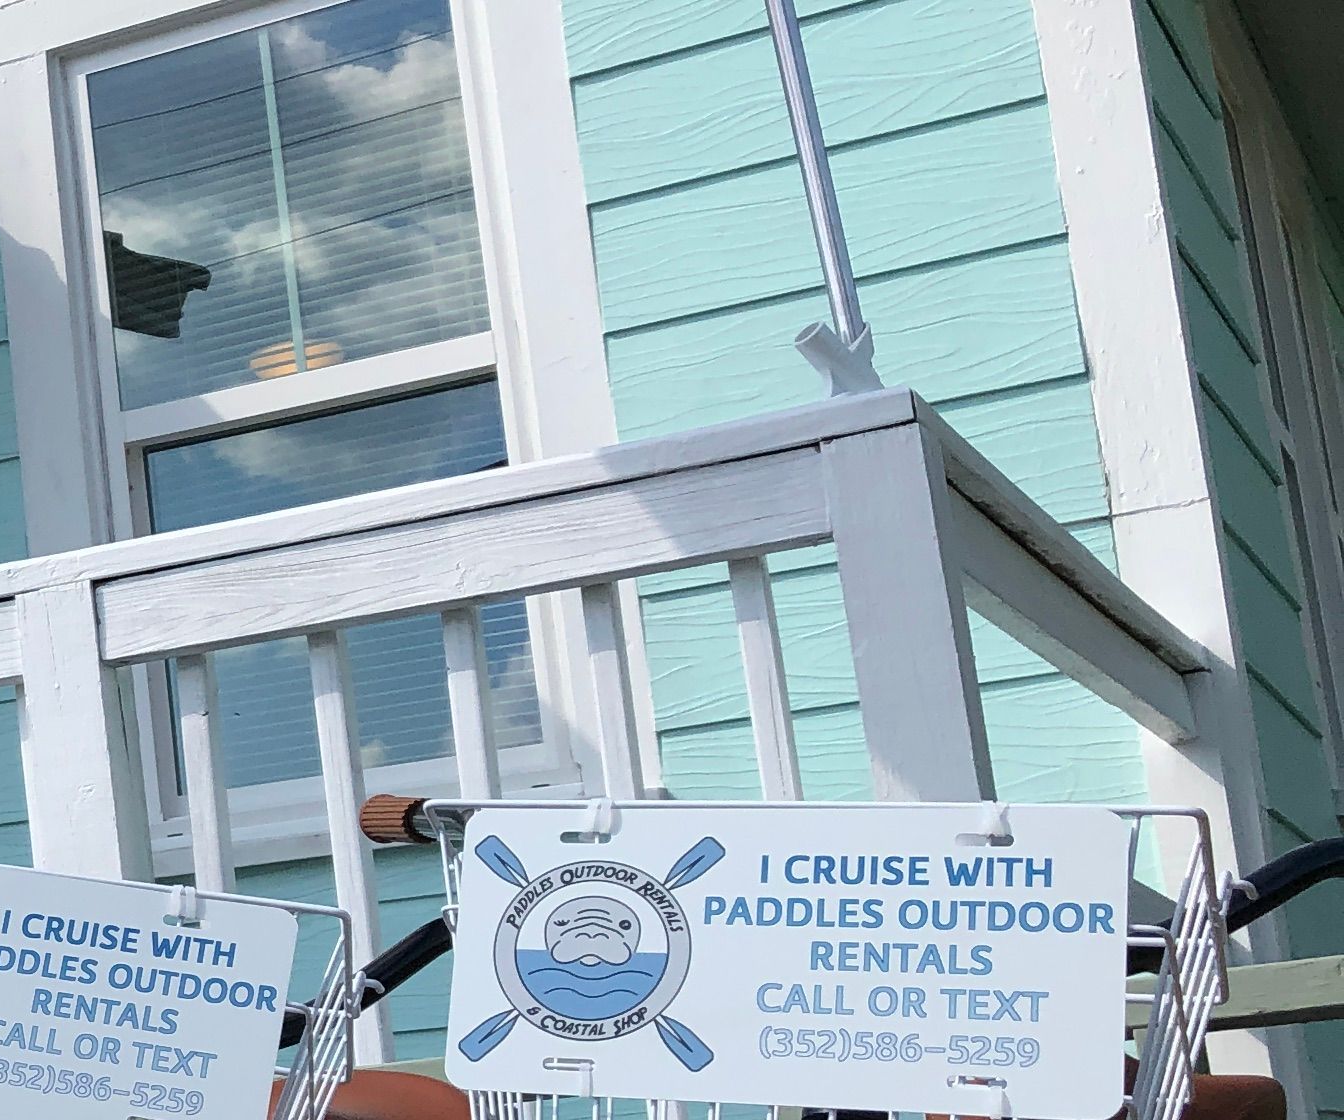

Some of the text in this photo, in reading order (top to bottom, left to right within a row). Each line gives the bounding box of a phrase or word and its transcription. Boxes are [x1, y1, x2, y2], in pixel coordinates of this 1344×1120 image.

[761, 855, 1052, 887] I CRUISE WITH
[506, 865, 683, 933] PADDLES OUTDOOR RENTALS
[704, 896, 1114, 933] PADDLES OUTDOOR
[1, 910, 237, 968] I CRUISE WITH
[810, 941, 992, 976] RENTALS
[108, 963, 278, 1013] OUTDOOR
[756, 982, 1049, 1022] CALL OR TEXT
[31, 988, 179, 1035] RENTALS
[540, 1015, 606, 1036] COASTAL
[613, 1006, 648, 1035] SHOP
[75, 1033, 121, 1064] OR
[132, 1042, 217, 1078] TEXT
[759, 1026, 1040, 1068] (352)586-5259
